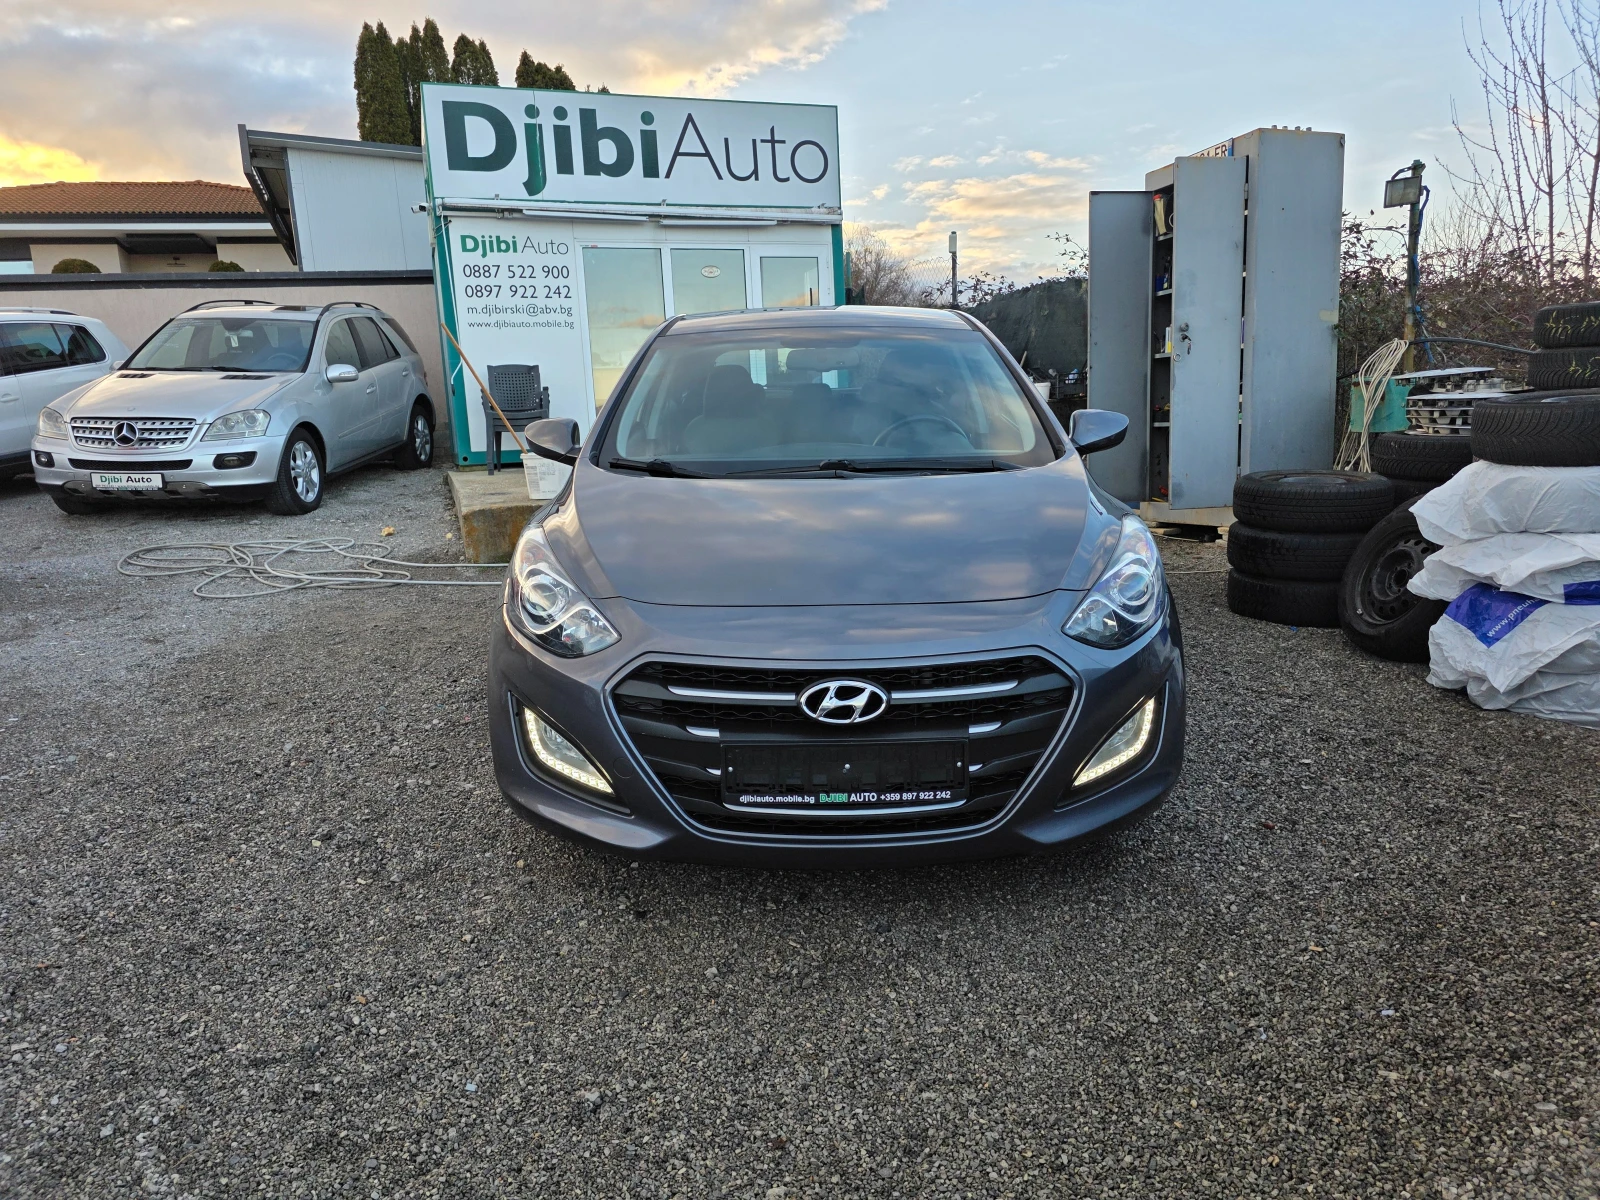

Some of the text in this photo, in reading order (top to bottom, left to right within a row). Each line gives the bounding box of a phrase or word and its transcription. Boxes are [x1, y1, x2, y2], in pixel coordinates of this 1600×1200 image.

[460, 235, 569, 258] Djibi Auto
[463, 264, 570, 279] 0887 522 900
[465, 285, 572, 299] 0897 922 242
[467, 303, 573, 317] m.djibirski@abv.bg
[467, 320, 575, 330] www.djibiauto.mobile.bg
[100, 475, 122, 484] Djibi
[739, 790, 951, 804] djibiauto.mobile.bg DJIBI AUTO +359 897 922 242
